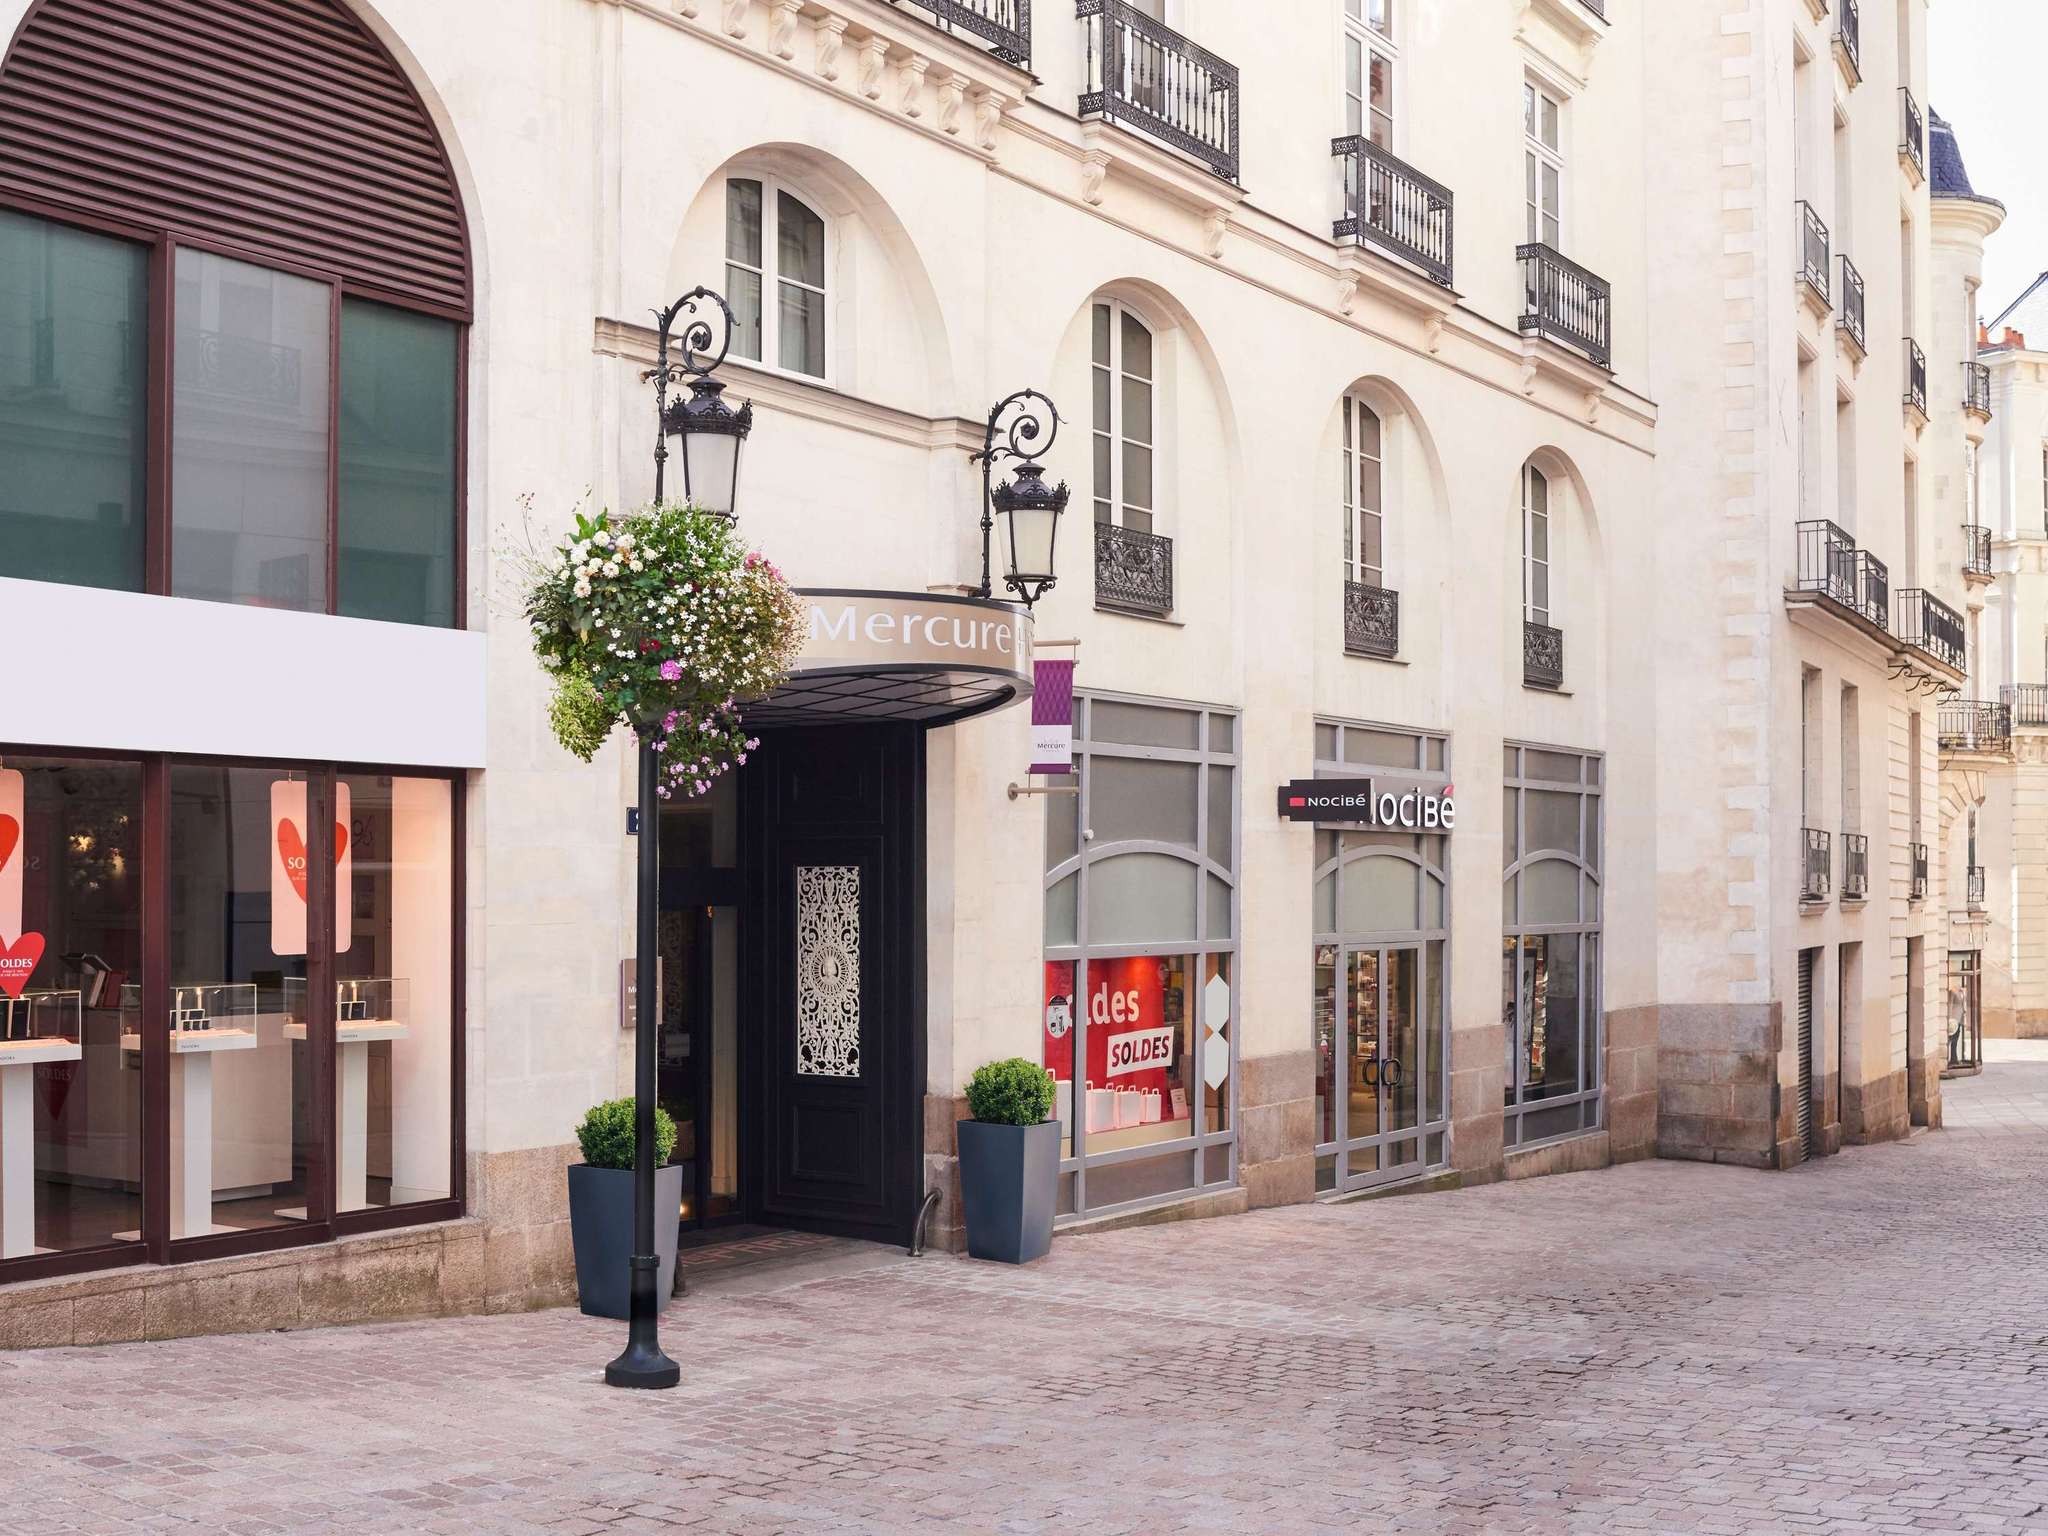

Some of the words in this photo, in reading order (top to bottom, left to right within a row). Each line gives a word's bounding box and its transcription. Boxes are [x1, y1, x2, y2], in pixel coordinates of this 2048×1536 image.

[810, 605, 1012, 653] Mercure
[287, 856, 306, 869] SO
[0, 958, 33, 968] OLDES
[1087, 981, 1140, 1026] des
[1111, 1035, 1170, 1068] SOLDES
